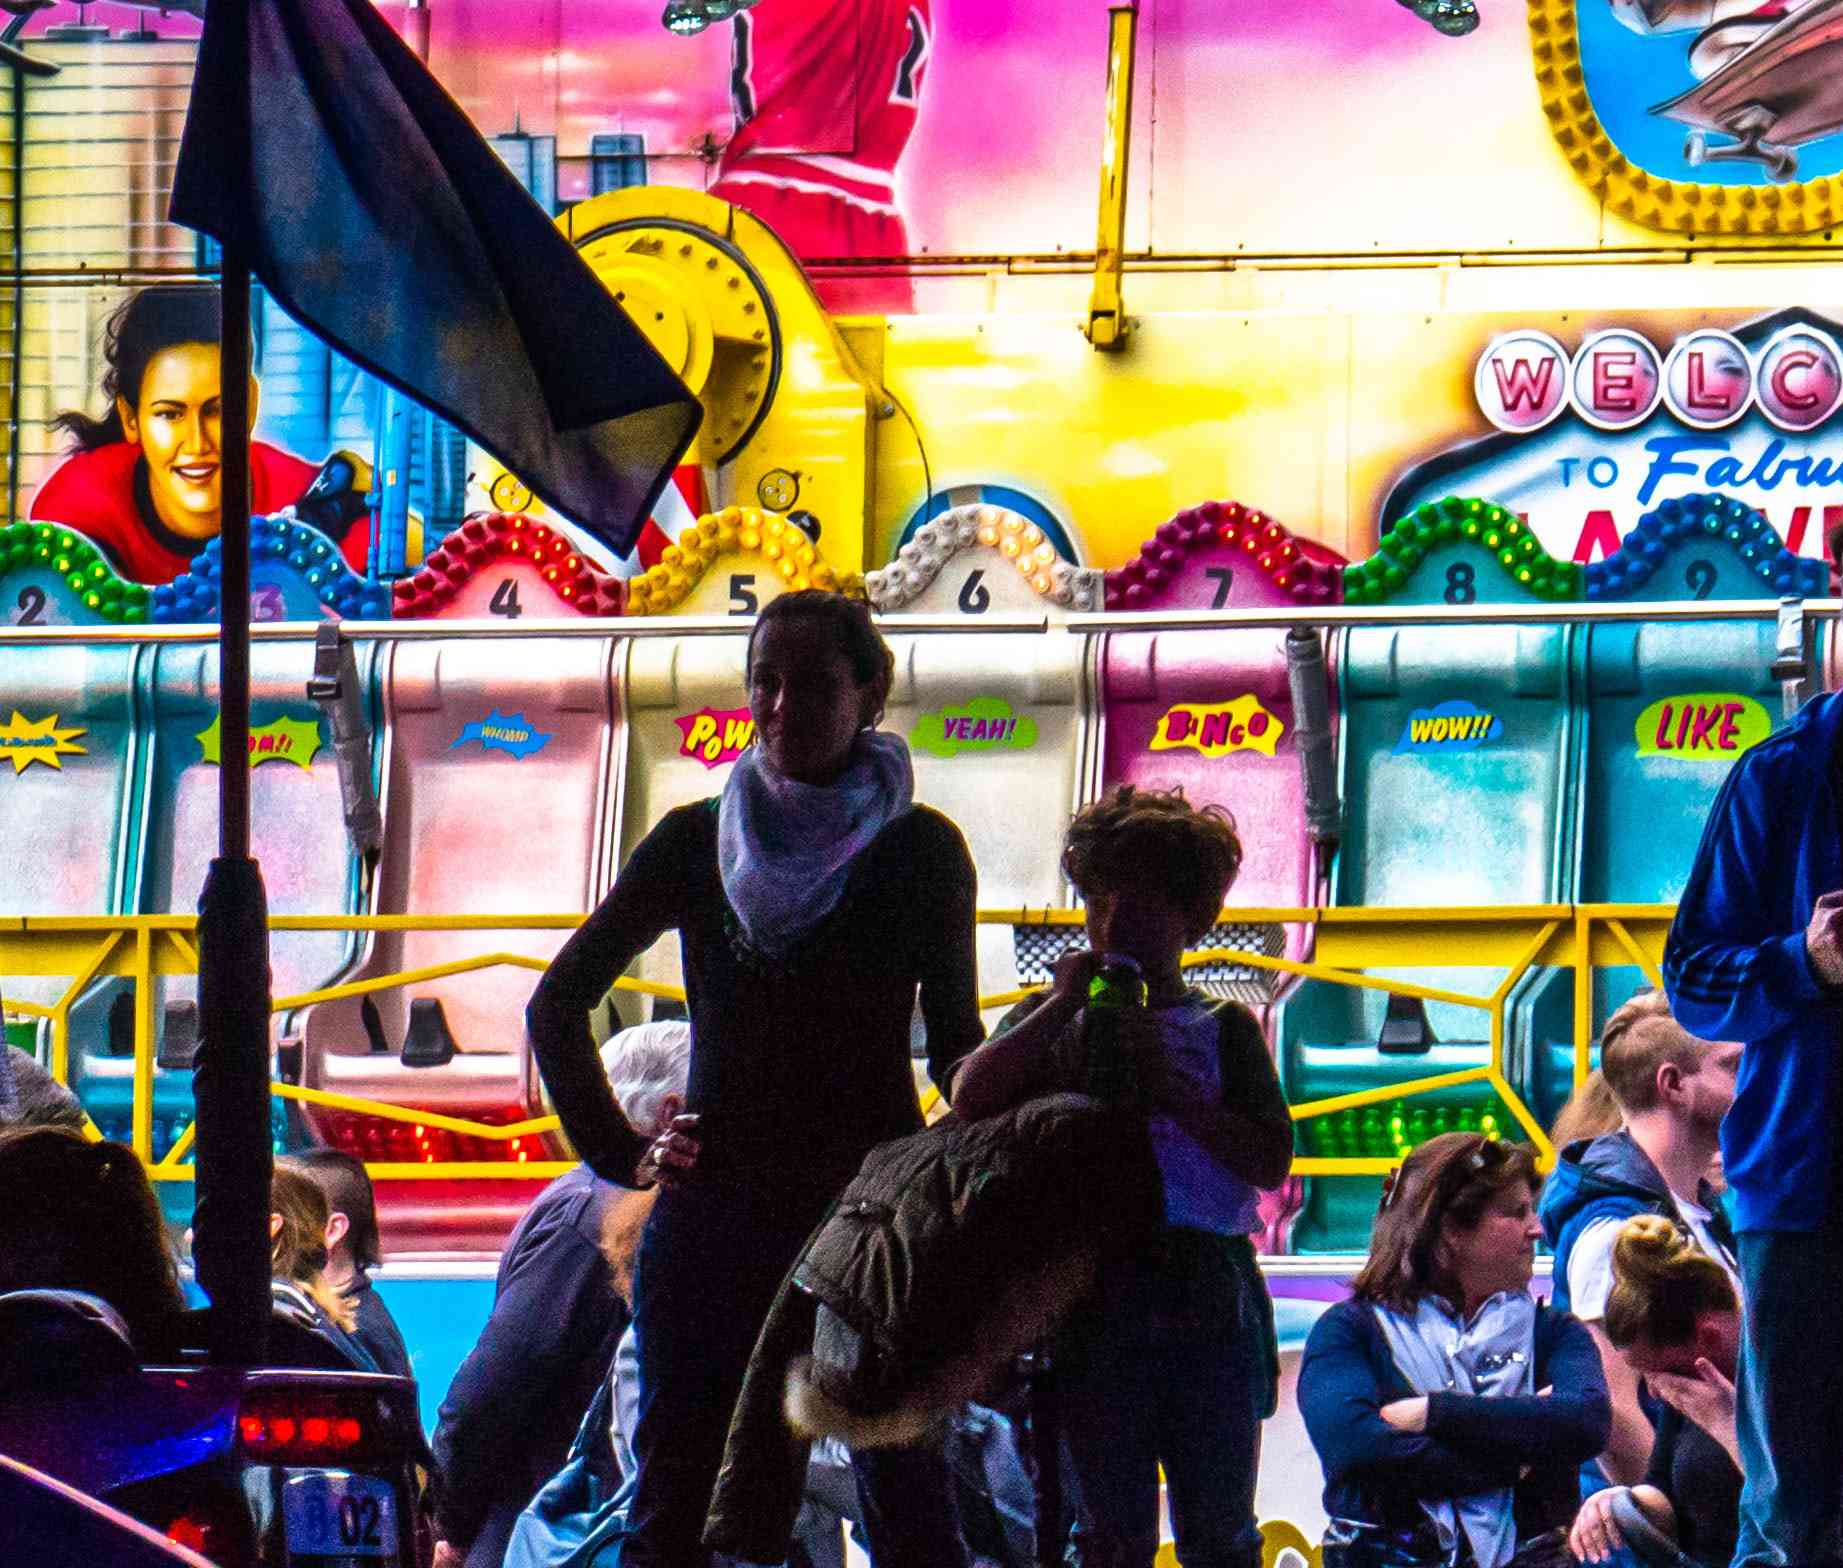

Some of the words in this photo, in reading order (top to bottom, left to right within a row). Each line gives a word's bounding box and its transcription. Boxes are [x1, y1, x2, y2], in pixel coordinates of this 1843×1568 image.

[1558, 456, 1619, 489] TO
[488, 577, 523, 619] 4
[727, 573, 759, 616] 5
[958, 568, 991, 615] 6
[1205, 567, 1234, 610] 7
[1443, 561, 1476, 605] 8
[1685, 558, 1719, 601] 9
[17, 585, 48, 627] 2
[943, 716, 1018, 741] YEAH!
[1165, 709, 1270, 748] BINGO
[1410, 713, 1494, 743] WOW!!
[1654, 702, 1746, 751] LIKE
